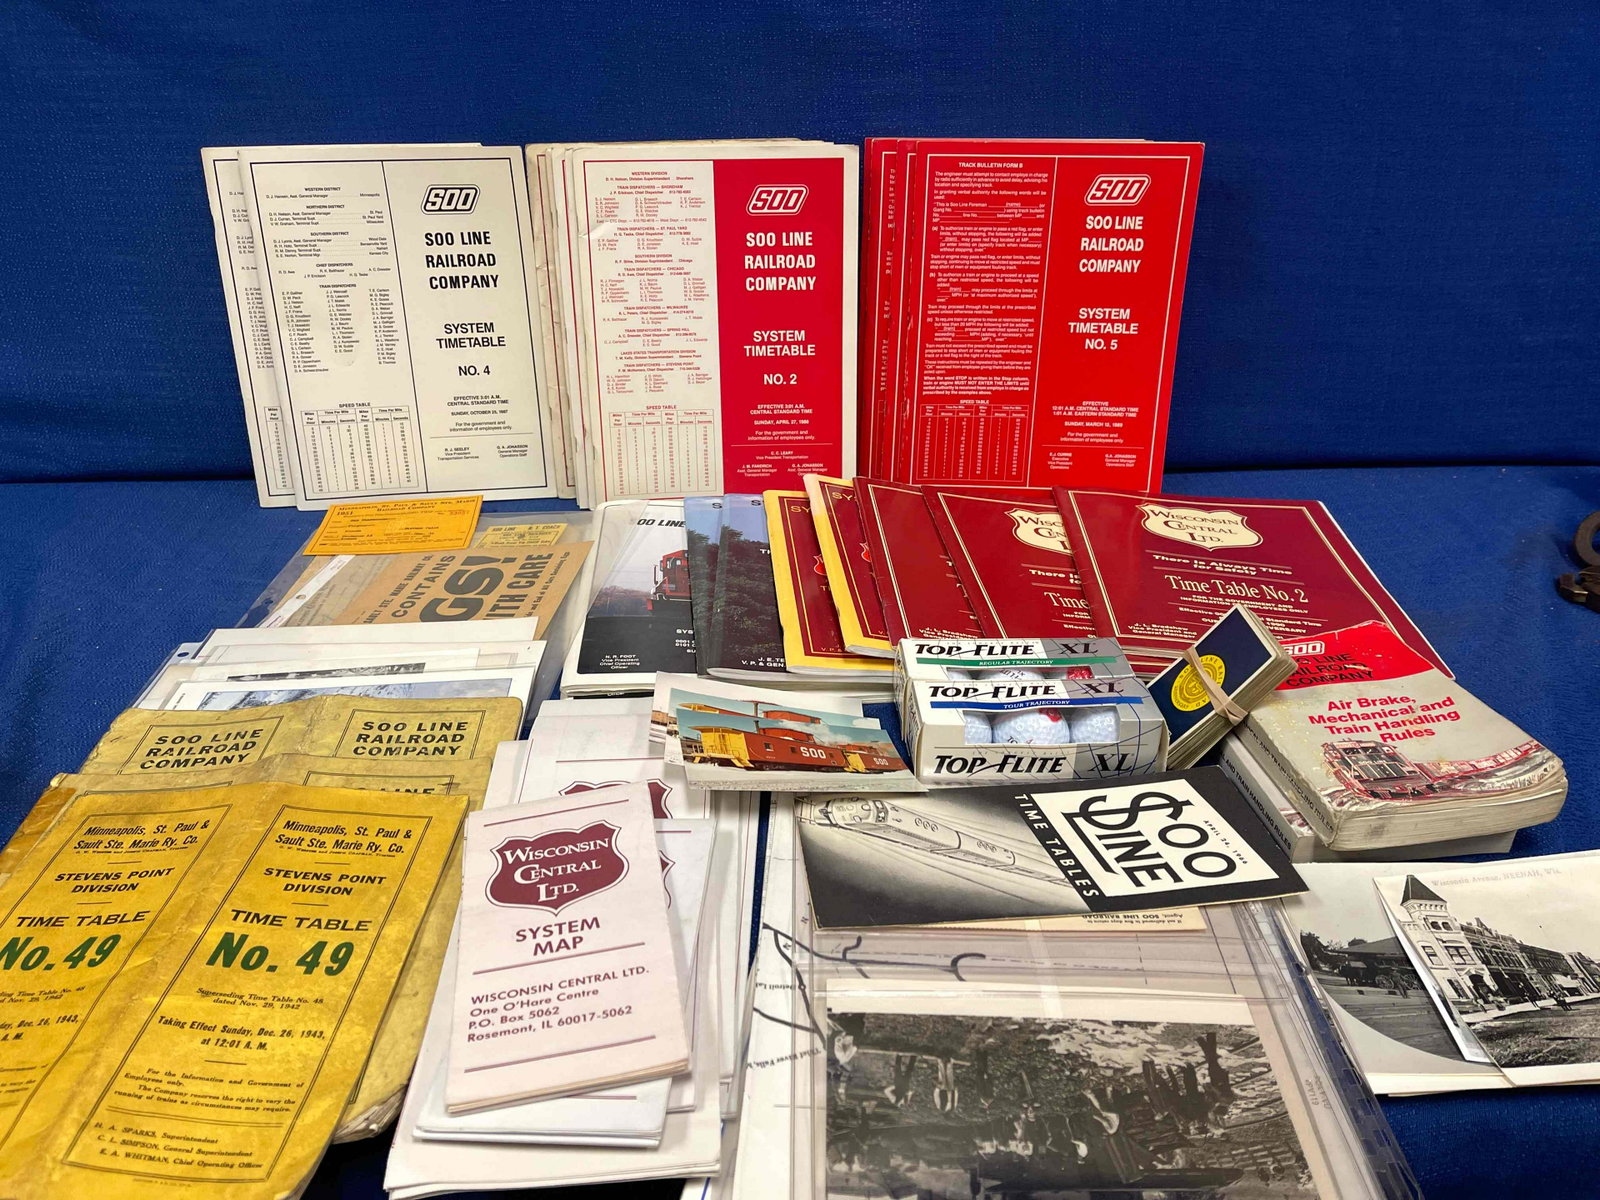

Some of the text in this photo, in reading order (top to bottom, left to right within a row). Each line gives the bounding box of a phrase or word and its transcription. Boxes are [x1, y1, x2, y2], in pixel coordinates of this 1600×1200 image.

[1086, 176, 1150, 204] SOO
[423, 186, 479, 213] SOO
[748, 186, 807, 213] SOO
[1086, 216, 1144, 230] SOO LINE
[424, 232, 491, 246] SOO LINE
[746, 232, 813, 247] SOO LINE
[1081, 238, 1144, 251] RAILROAD
[426, 254, 496, 268] RAILROAD
[744, 254, 815, 269] RAILROAD
[1079, 259, 1141, 272] COMPANY
[429, 275, 499, 289] COMPANY
[746, 276, 816, 291] COMPANY
[1079, 308, 1130, 319] SYSTEM
[444, 322, 495, 334] SYSTEM
[753, 330, 805, 342] SYSTEM
[1068, 322, 1138, 334] TIMETABLE
[436, 336, 506, 349] TIMETABLE
[744, 345, 815, 356] TIMETABLE
[1085, 339, 1118, 350] NO. 5
[458, 366, 491, 376] NO. 4
[764, 374, 797, 385] NO. 2
[1150, 509, 1239, 525] WISCONSIN
[1163, 519, 1238, 535] CENTRAL
[1186, 532, 1224, 543] LTD.
[1153, 555, 1190, 564] There
[1209, 561, 1256, 572] Always
[1260, 567, 1293, 575] Time
[1215, 566, 1258, 576] Safety
[391, 555, 456, 618] CONTAINS
[1165, 575, 1309, 603] Time Table No. 2
[915, 643, 1098, 656] TOP FLITE XL
[1314, 653, 1356, 663] LINE
[1292, 662, 1367, 677] AILROAD
[1286, 670, 1374, 687] COMPANY
[929, 682, 1123, 698] TOP FLITE XL
[1308, 696, 1455, 725] Mechanical and
[1327, 695, 1416, 711] Air Brake,
[361, 721, 468, 732] SOO LINE
[1324, 710, 1461, 735] Train Handling
[156, 728, 264, 745] SOO LINE
[355, 733, 466, 744] RAILROAD
[1380, 727, 1436, 743] Rules
[145, 740, 258, 758] RAILROAD
[352, 746, 461, 756] COMPANY
[800, 747, 827, 759] SOO
[139, 752, 251, 770] COMPANY
[934, 754, 1132, 774] TOP FLITE XL
[83, 820, 209, 836] Minneapolis, St. Paul &
[283, 820, 412, 839] Minneapolis, St. Paul &
[1079, 791, 1237, 878] SOO
[1203, 820, 1220, 837] APRIL
[74, 840, 103, 850] Sault
[104, 840, 125, 849] Ste.
[129, 839, 159, 849] Marie
[161, 837, 178, 847] Ry.
[183, 835, 199, 844] Co.
[275, 834, 303, 847] Sault
[307, 837, 327, 849] Ste.
[332, 839, 362, 851] Marie
[366, 841, 382, 853] Ry.
[387, 843, 405, 854] Co.
[1014, 794, 1048, 830] TIME
[1046, 838, 1099, 899] TABLES
[502, 838, 610, 865] WISCONSIN
[54, 867, 176, 881] STEVENS POINT
[263, 868, 387, 885] STEVENS POINT
[513, 859, 602, 884] CENTRAL
[71, 883, 140, 893] DIVISION
[283, 883, 354, 896] DIVISION
[536, 882, 579, 903] LTD.
[16, 911, 151, 928] TIME TABLE
[230, 909, 372, 931] TIME TABLE
[515, 917, 601, 943] SYSTEM
[63, 934, 122, 970] 49
[533, 936, 584, 956] MAP
[206, 932, 354, 977] No. 49
[471, 965, 650, 1005] WISCONSIN CENTRAL LTD.
[470, 988, 599, 1017] One O'Hare Centre
[467, 1005, 633, 1043] Rosemont, IL 60017-5062
[468, 1006, 560, 1030] P.O. Box 5062
[158, 1016, 325, 1039] Taking Effect Sunday, Dec. 26, 1943,
[214, 1038, 240, 1049] 12:01
[244, 1042, 252, 1050] A.
[257, 1042, 268, 1050] M.
